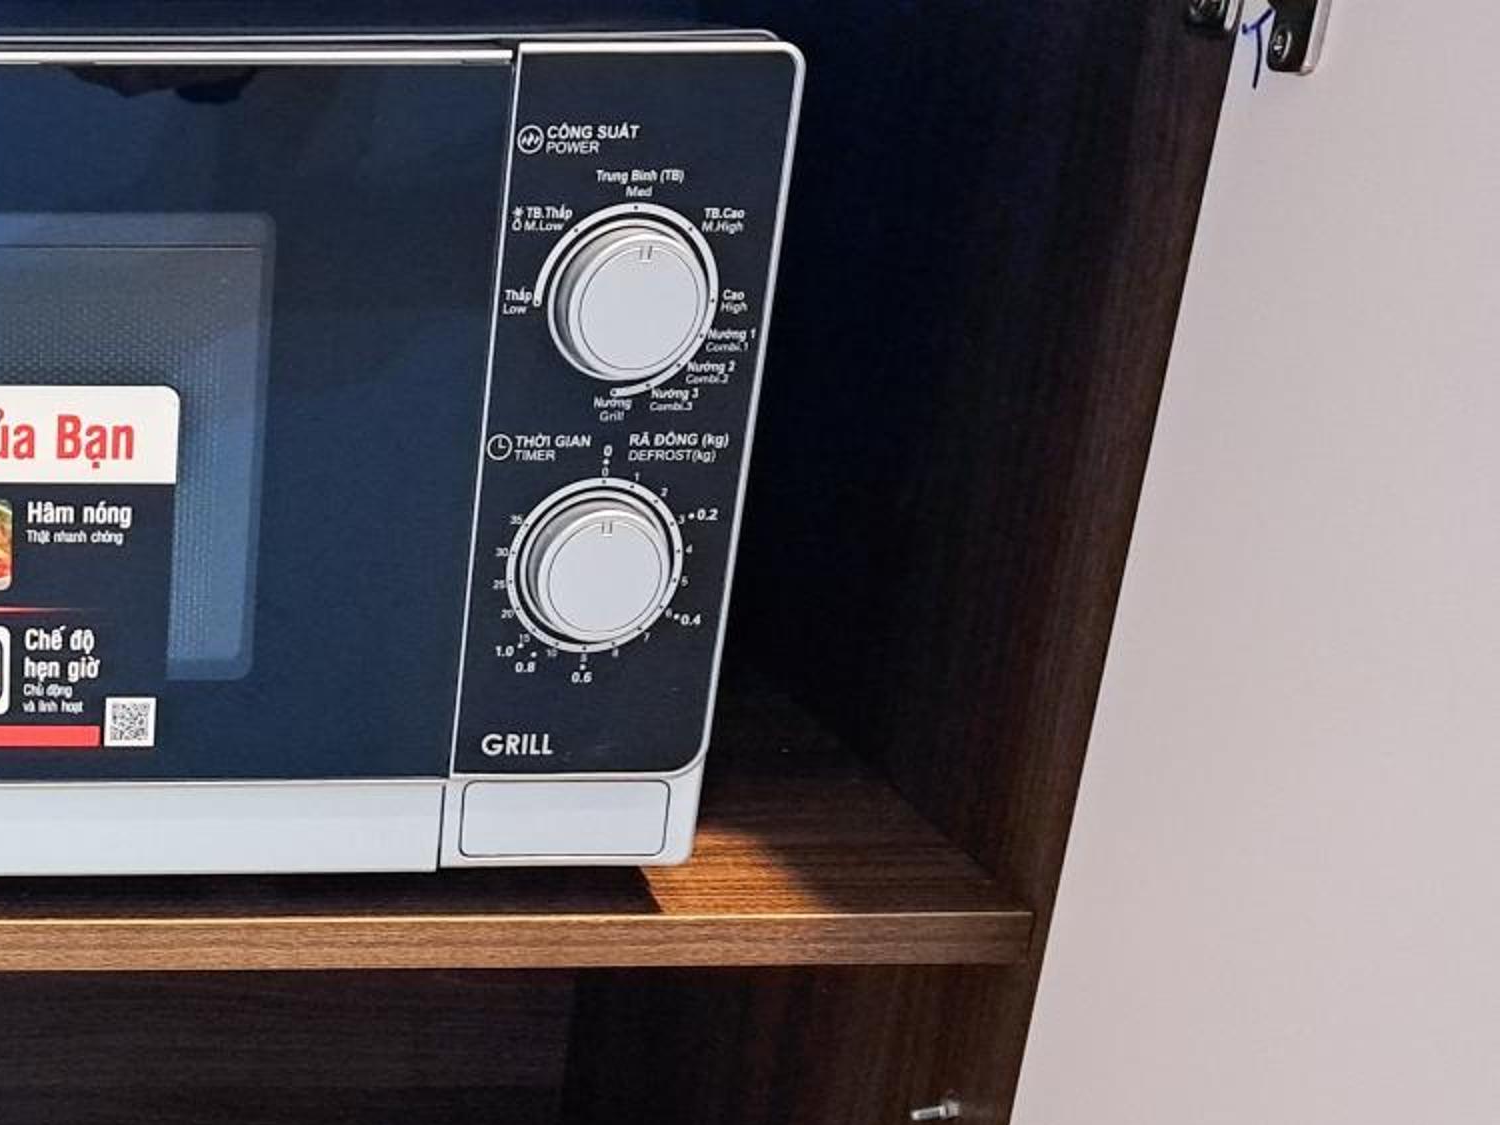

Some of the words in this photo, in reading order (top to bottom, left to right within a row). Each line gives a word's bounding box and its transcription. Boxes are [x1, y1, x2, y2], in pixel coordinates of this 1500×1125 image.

[547, 122, 593, 139] CÔNG
[546, 141, 600, 154] POWER
[596, 169, 628, 185] Trung
[660, 169, 685, 183] (TB)
[625, 186, 653, 197] Med
[704, 208, 745, 219] TB.Cao
[524, 220, 565, 231] M.Low
[701, 221, 744, 234] M.High
[722, 289, 746, 300] Cao
[503, 303, 527, 314] Low
[720, 302, 748, 314] High
[750, 328, 756, 339] 1
[728, 360, 736, 372] 2
[692, 387, 699, 399] 3
[599, 410, 625, 421] Grill
[56, 414, 134, 469] Bạn
[555, 434, 591, 448] GIAN
[629, 431, 650, 446] RÃ
[701, 432, 729, 449] (kg)
[514, 449, 556, 461] TIMER
[603, 444, 613, 457] 0
[635, 471, 640, 481] 1
[27, 501, 75, 523] Hâm
[83, 501, 132, 528] nóng
[697, 508, 718, 521] 0.2
[53, 530, 88, 543] nhanh
[685, 544, 693, 554] 4
[680, 614, 701, 626] 0.4
[24, 625, 66, 650] Chế
[70, 629, 95, 654] độ
[496, 645, 514, 657] 1.0
[24, 656, 60, 682] hẹn
[67, 656, 101, 682] giờ
[515, 661, 536, 673] 0.8
[571, 671, 592, 683] 0.6
[481, 733, 553, 756] GRILL
